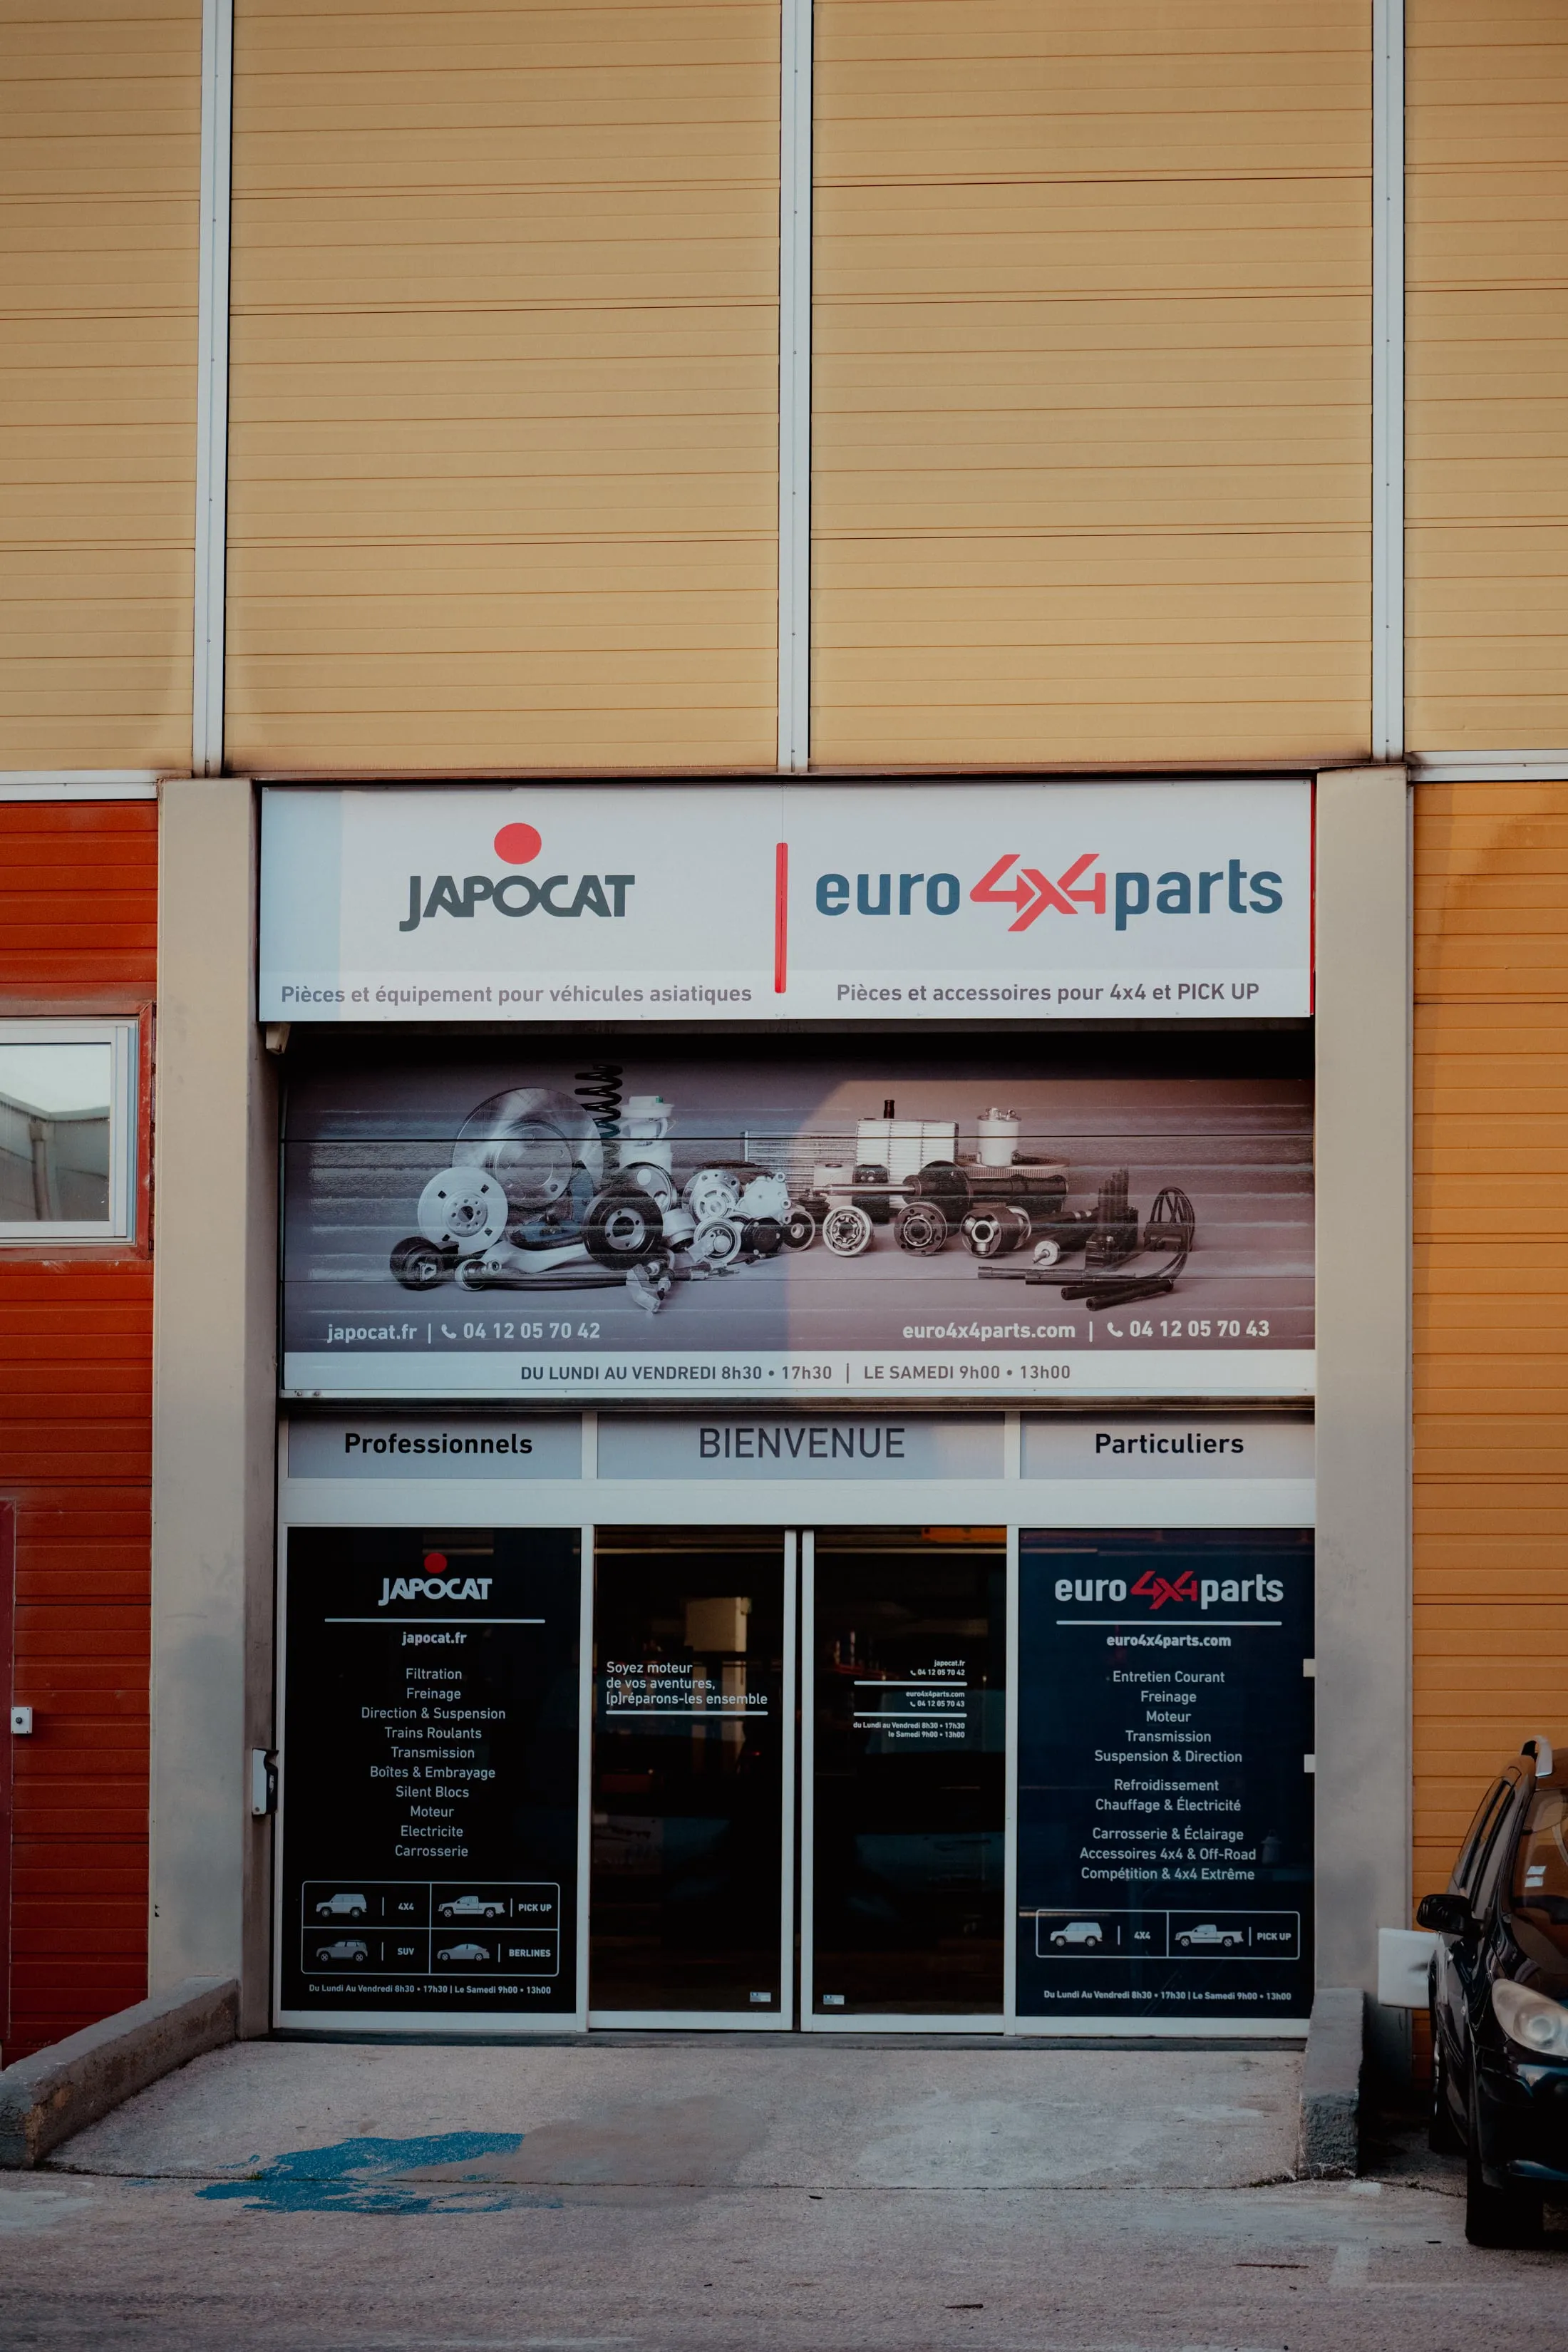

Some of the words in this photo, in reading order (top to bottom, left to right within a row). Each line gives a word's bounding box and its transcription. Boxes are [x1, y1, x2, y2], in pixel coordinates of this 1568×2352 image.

[398, 875, 636, 932] JAPOCAT
[282, 985, 346, 1003] Pièces
[351, 986, 370, 1003] et
[376, 985, 492, 1006] équipement
[498, 989, 545, 1006] pour
[549, 984, 644, 1002] véhicules
[649, 984, 752, 1006] asiatiques
[837, 984, 902, 1001] Pièces
[908, 985, 927, 1001] et
[933, 984, 1051, 1001] accessoires
[1058, 988, 1104, 1005] pour
[1110, 983, 1147, 1001] 4x4
[1152, 984, 1172, 1001] et
[1177, 983, 1225, 1000] PICK
[1232, 983, 1259, 1000] UP
[326, 1323, 418, 1343] japocat.fr
[463, 1322, 487, 1339] 04
[493, 1322, 515, 1339] 12
[520, 1322, 543, 1339] 05
[549, 1322, 572, 1339] 70
[577, 1322, 600, 1339] 42
[902, 1321, 1076, 1342] euro4x4parts.com
[1130, 1320, 1154, 1337] 04
[1160, 1320, 1182, 1337] 12
[1187, 1320, 1211, 1337] 05
[1217, 1319, 1240, 1337] 70
[1246, 1319, 1269, 1337] 43
[521, 1366, 544, 1381] DU
[549, 1366, 599, 1381] LUNDI
[604, 1366, 627, 1380] AU
[631, 1366, 716, 1380] VENDREDI
[721, 1366, 762, 1380] 8h30
[782, 1366, 832, 1380] 17h30
[864, 1366, 884, 1380] LE
[889, 1366, 954, 1379] SAMEDI
[959, 1365, 1000, 1379] 9h00
[1020, 1365, 1071, 1379] 13h00
[345, 1432, 532, 1454] Professionnels
[698, 1427, 906, 1458] BIENVENUE
[1095, 1433, 1244, 1454] Particuliers
[378, 1577, 493, 1606] JAPOCAT
[401, 1631, 468, 1646] japocat.fr
[1106, 1634, 1232, 1649] euro4x4parts.com
[607, 1661, 644, 1676] Soyez
[647, 1662, 693, 1673] moteur
[934, 1659, 966, 1668] japocat.fr
[406, 1668, 463, 1680] Filtration
[1113, 1670, 1171, 1683] Entretien
[1175, 1670, 1225, 1683] Courant
[606, 1676, 621, 1689] de
[624, 1679, 646, 1688] vos
[649, 1678, 716, 1691] aventures,
[406, 1687, 461, 1702] Freinage
[606, 1691, 703, 1707] [p]réparons-les
[706, 1691, 768, 1706] ensemble
[905, 1690, 965, 1698] euro4x4parts.com
[1140, 1690, 1197, 1706] Freinage
[361, 1706, 417, 1719] Direction
[421, 1707, 430, 1719] &
[433, 1707, 506, 1722] Suspension
[1146, 1710, 1192, 1723] Moteur
[384, 1726, 423, 1738] Trains
[427, 1726, 482, 1739] Roulants
[1125, 1730, 1212, 1743] Transmission
[391, 1746, 475, 1758] Transmission
[1094, 1749, 1169, 1765] Suspension
[1172, 1750, 1182, 1763] &
[1185, 1750, 1242, 1763] Direction
[370, 1765, 409, 1778] Boîtes
[412, 1765, 421, 1778] &
[425, 1765, 496, 1781] Embrayage
[396, 1785, 432, 1797] Silent
[435, 1785, 470, 1798] Blocs
[1114, 1778, 1219, 1791] Refroidissement
[410, 1805, 455, 1817] Moteur
[1095, 1798, 1160, 1814] Chauffage
[1163, 1798, 1173, 1811] &
[1177, 1795, 1242, 1812] Électricité
[401, 1825, 463, 1837] Electricite
[1092, 1827, 1167, 1840] Carrosserie
[1171, 1827, 1181, 1840] &
[1184, 1825, 1244, 1843] Éclairage
[395, 1844, 468, 1857] Carrosserie
[1079, 1847, 1157, 1860] Accessoires
[1160, 1847, 1184, 1860] 4x4
[1187, 1847, 1197, 1860] &
[1200, 1847, 1257, 1860] Off-Road
[1081, 1867, 1158, 1882] Compétition
[1161, 1867, 1171, 1880] &
[1174, 1867, 1198, 1880] 4x4
[1201, 1867, 1255, 1880] Extrême
[398, 1902, 415, 1911] 4X4
[518, 1903, 539, 1912] PICK
[1133, 1931, 1151, 1940] 4X4
[1257, 1932, 1278, 1941] PICK
[1279, 1932, 1291, 1941] UP
[397, 1947, 415, 1956] SUV
[509, 1949, 551, 1958] BERLINES
[309, 1984, 320, 1993] Du
[321, 1984, 344, 1993] Lundi
[345, 1984, 356, 1993] Au
[358, 1984, 393, 1993] Vendredi
[394, 1985, 415, 1993] 8h30
[423, 1985, 448, 1993] 17h30
[454, 1985, 465, 1993] Le
[466, 1985, 496, 1994] Samedi
[497, 1986, 518, 1994] 9h00
[526, 1986, 552, 1994] 13h00
[1043, 1990, 1056, 1998] Du
[1056, 1990, 1080, 1998] Lundi
[1080, 1990, 1093, 1999] Au
[1093, 1990, 1130, 1999] Vendredi
[1131, 1991, 1152, 1999] 8h30
[1160, 1991, 1186, 2000] 17h30
[1192, 1991, 1204, 2000] Le
[1205, 1991, 1236, 2000] Samedi
[1237, 1991, 1258, 2000] 9h00
[1266, 1992, 1291, 2001] 13h00
